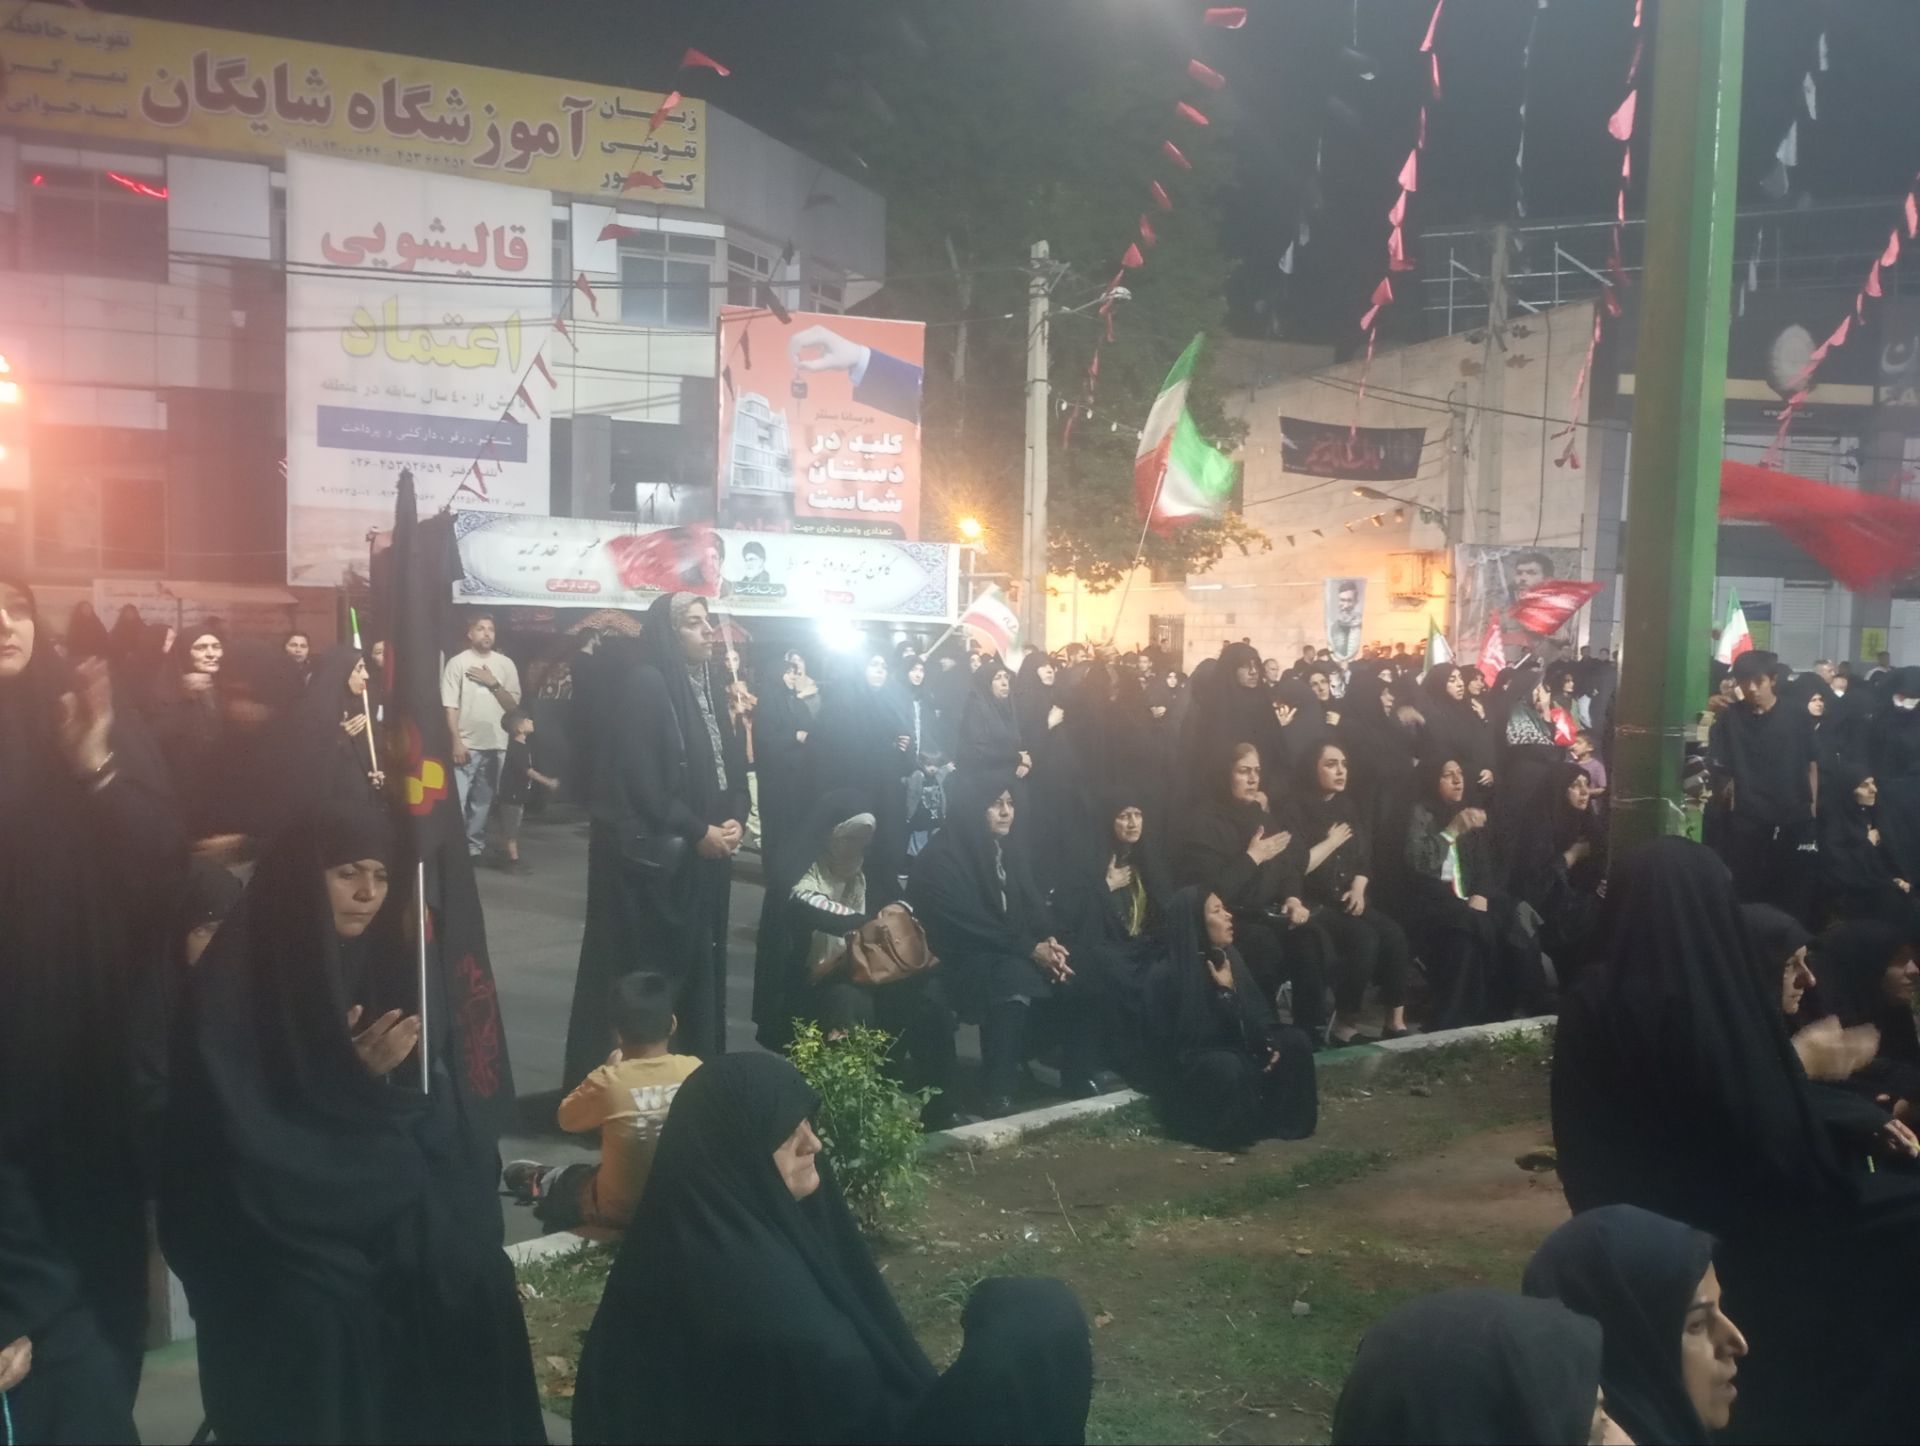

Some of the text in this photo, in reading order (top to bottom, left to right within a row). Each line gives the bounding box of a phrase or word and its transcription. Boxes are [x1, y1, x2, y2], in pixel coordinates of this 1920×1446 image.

[141, 52, 594, 172] آموزشگاه شایگان
[600, 97, 697, 131] زبان
[600, 138, 697, 161] تقویتی
[321, 217, 529, 277] قالیشویی
[341, 295, 522, 373] اعتماد
[363, 384, 379, 397] در
[420, 388, 447, 405] سال
[810, 431, 903, 459] کلید در
[808, 458, 905, 484] دستان
[808, 488, 902, 513] شماست
